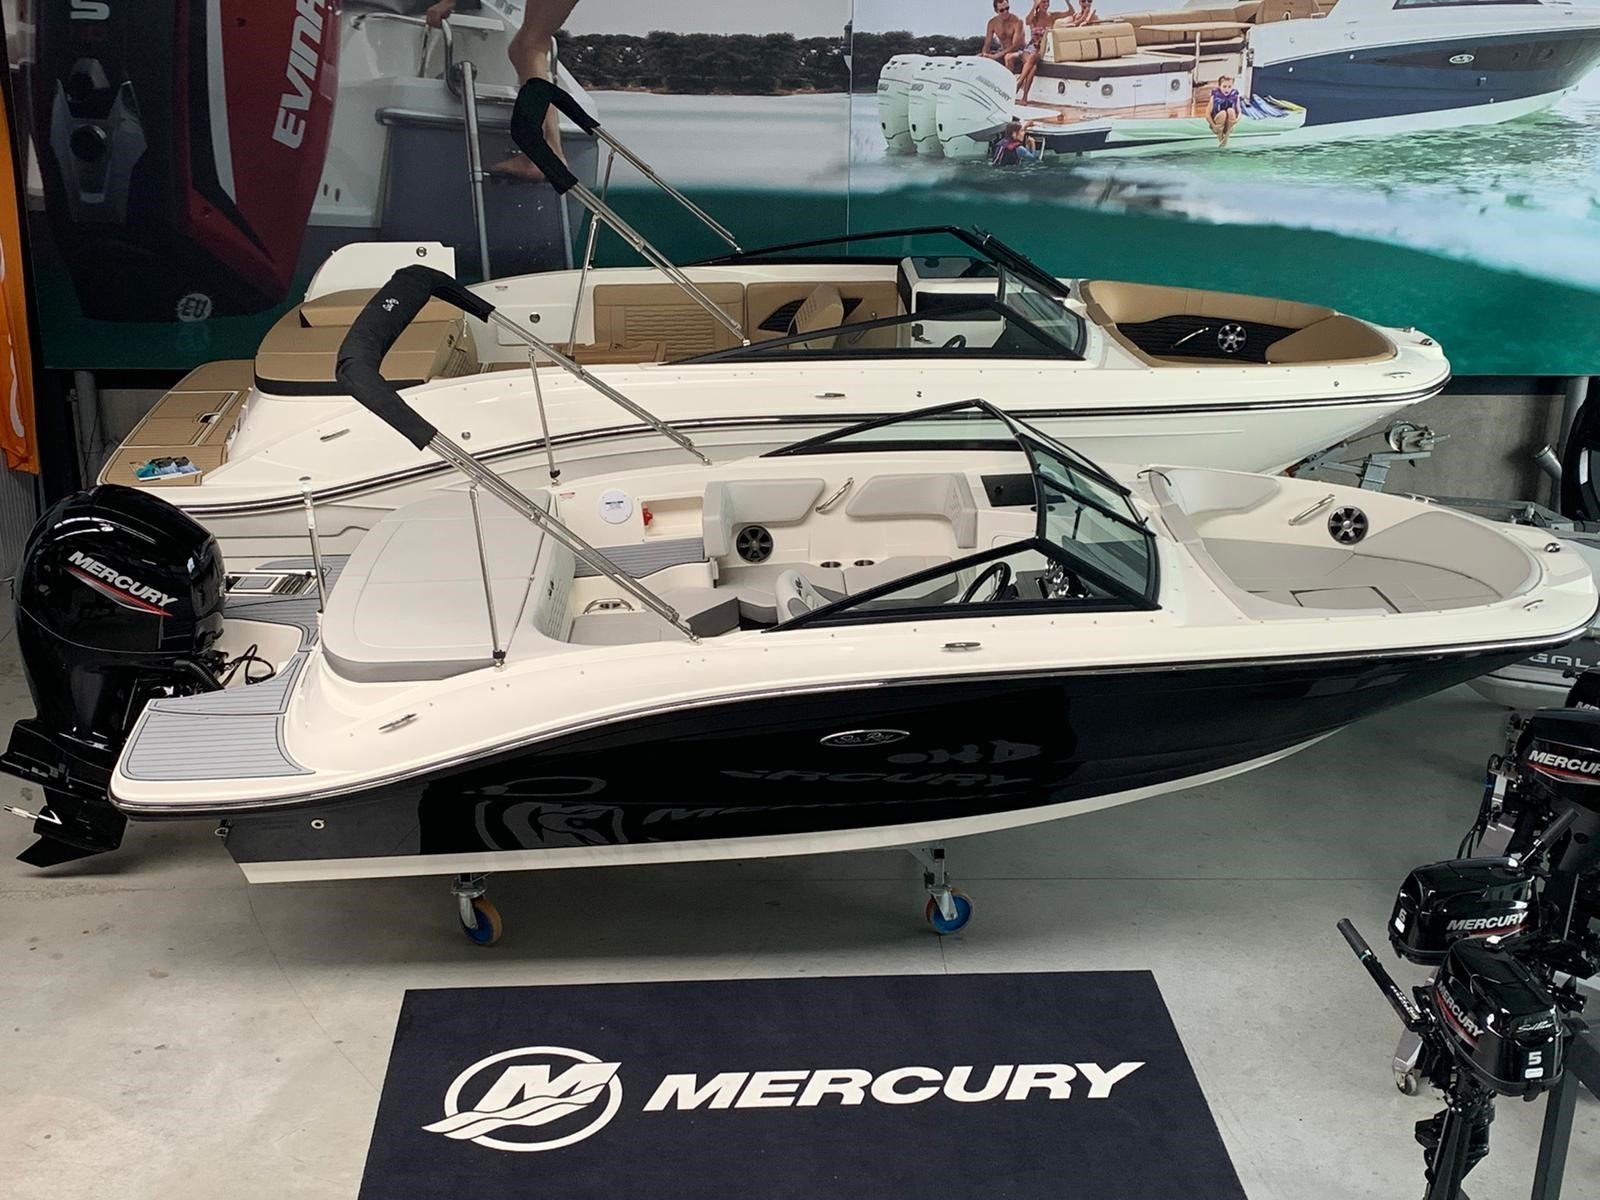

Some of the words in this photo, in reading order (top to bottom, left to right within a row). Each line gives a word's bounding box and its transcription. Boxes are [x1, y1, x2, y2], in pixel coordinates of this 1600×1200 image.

[68, 550, 179, 607] MERCURY
[1446, 911, 1529, 931] MERCURY
[1437, 980, 1484, 1037] MERCURY
[1528, 1051, 1542, 1066] 5
[642, 1061, 1146, 1112] MERCURY
